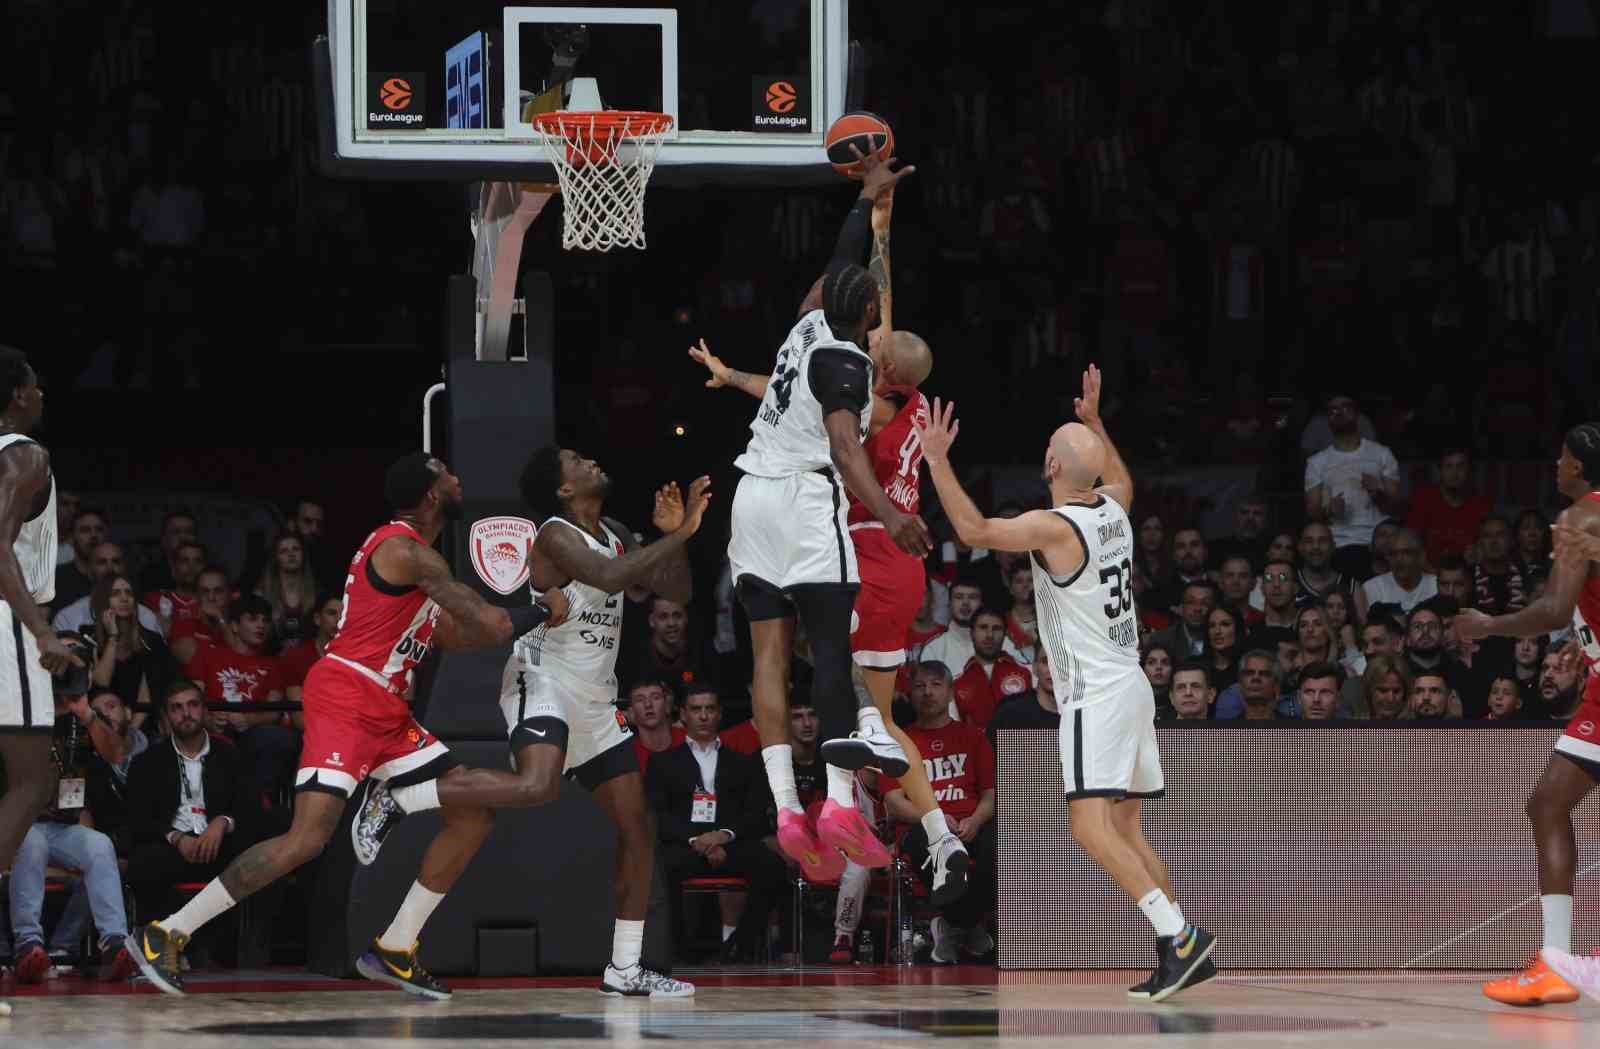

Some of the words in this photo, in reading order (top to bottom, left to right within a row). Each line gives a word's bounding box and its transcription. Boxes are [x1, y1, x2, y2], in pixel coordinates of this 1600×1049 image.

[369, 112, 423, 124] EuroLeague
[755, 115, 807, 127] EuroLeague
[478, 522, 529, 535] OLYMPIACOS
[1099, 557, 1132, 619] 33
